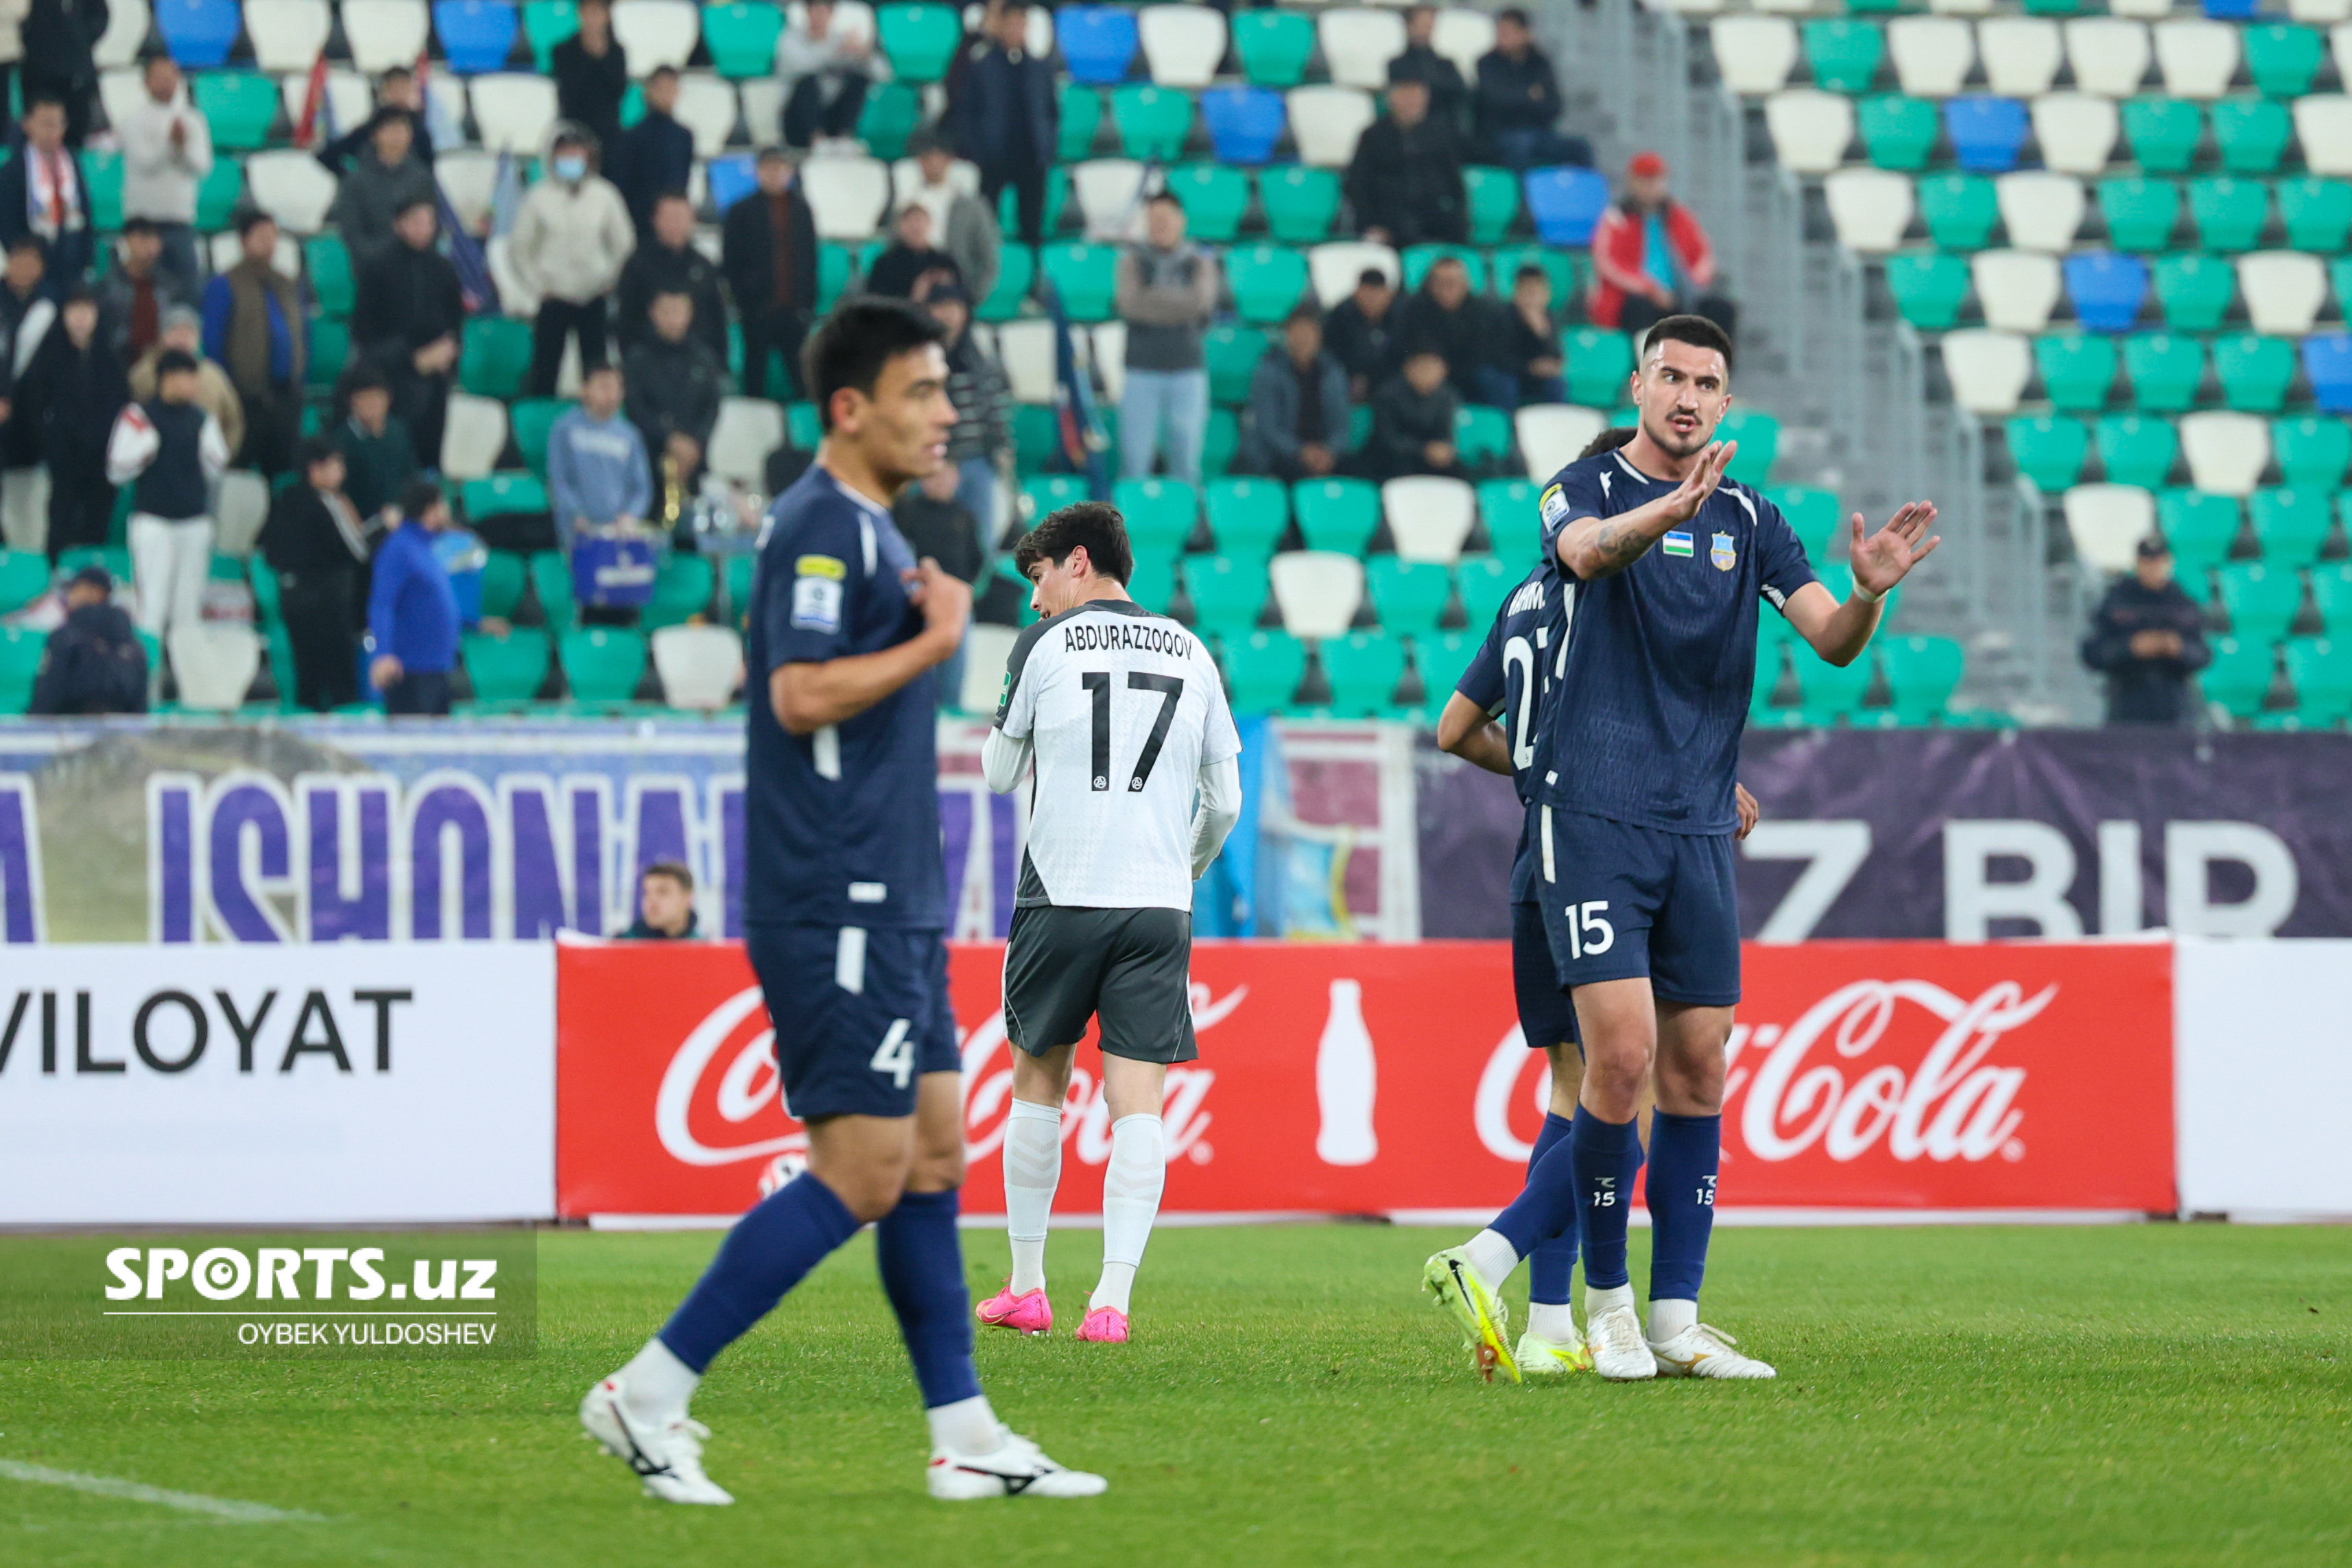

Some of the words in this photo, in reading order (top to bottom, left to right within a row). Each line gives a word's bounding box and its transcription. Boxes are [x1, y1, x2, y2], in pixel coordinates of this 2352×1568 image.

[1065, 624, 1192, 661] ABDURAZZOQOV
[1503, 626, 1549, 770] 2
[1082, 671, 1184, 792] 17
[1565, 900, 1615, 960] 15
[869, 1017, 916, 1090] 4
[1593, 1191, 1616, 1207] 15
[1696, 1188, 1714, 1205] 15
